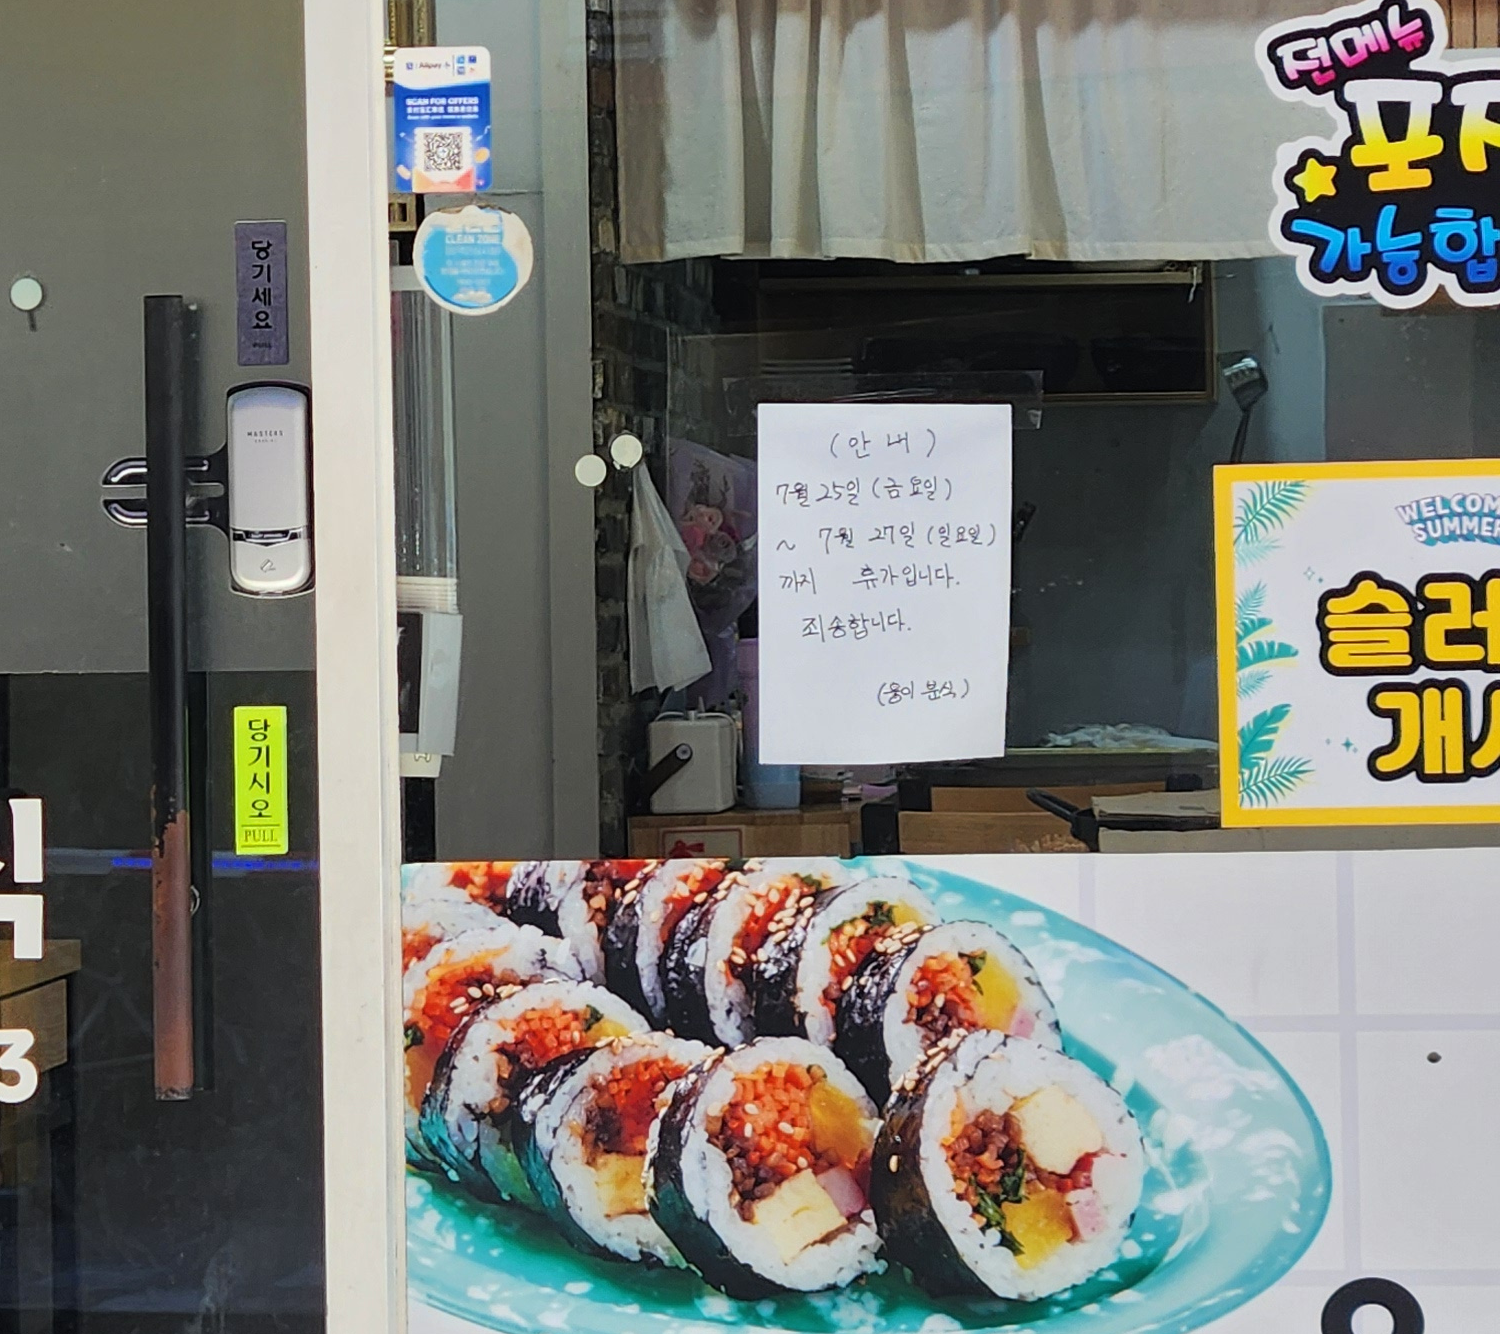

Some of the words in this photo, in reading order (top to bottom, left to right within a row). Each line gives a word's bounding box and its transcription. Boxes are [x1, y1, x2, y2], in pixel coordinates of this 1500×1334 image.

[1276, 4, 1425, 86] 전메뉴
[251, 239, 274, 330] 당기세요
[816, 476, 861, 507] 25일
[868, 521, 915, 549] 27일
[779, 567, 818, 595] 까지
[802, 607, 912, 643] 죄송합니다.
[248, 718, 273, 819] 당기시오
[244, 829, 279, 844] PULL
